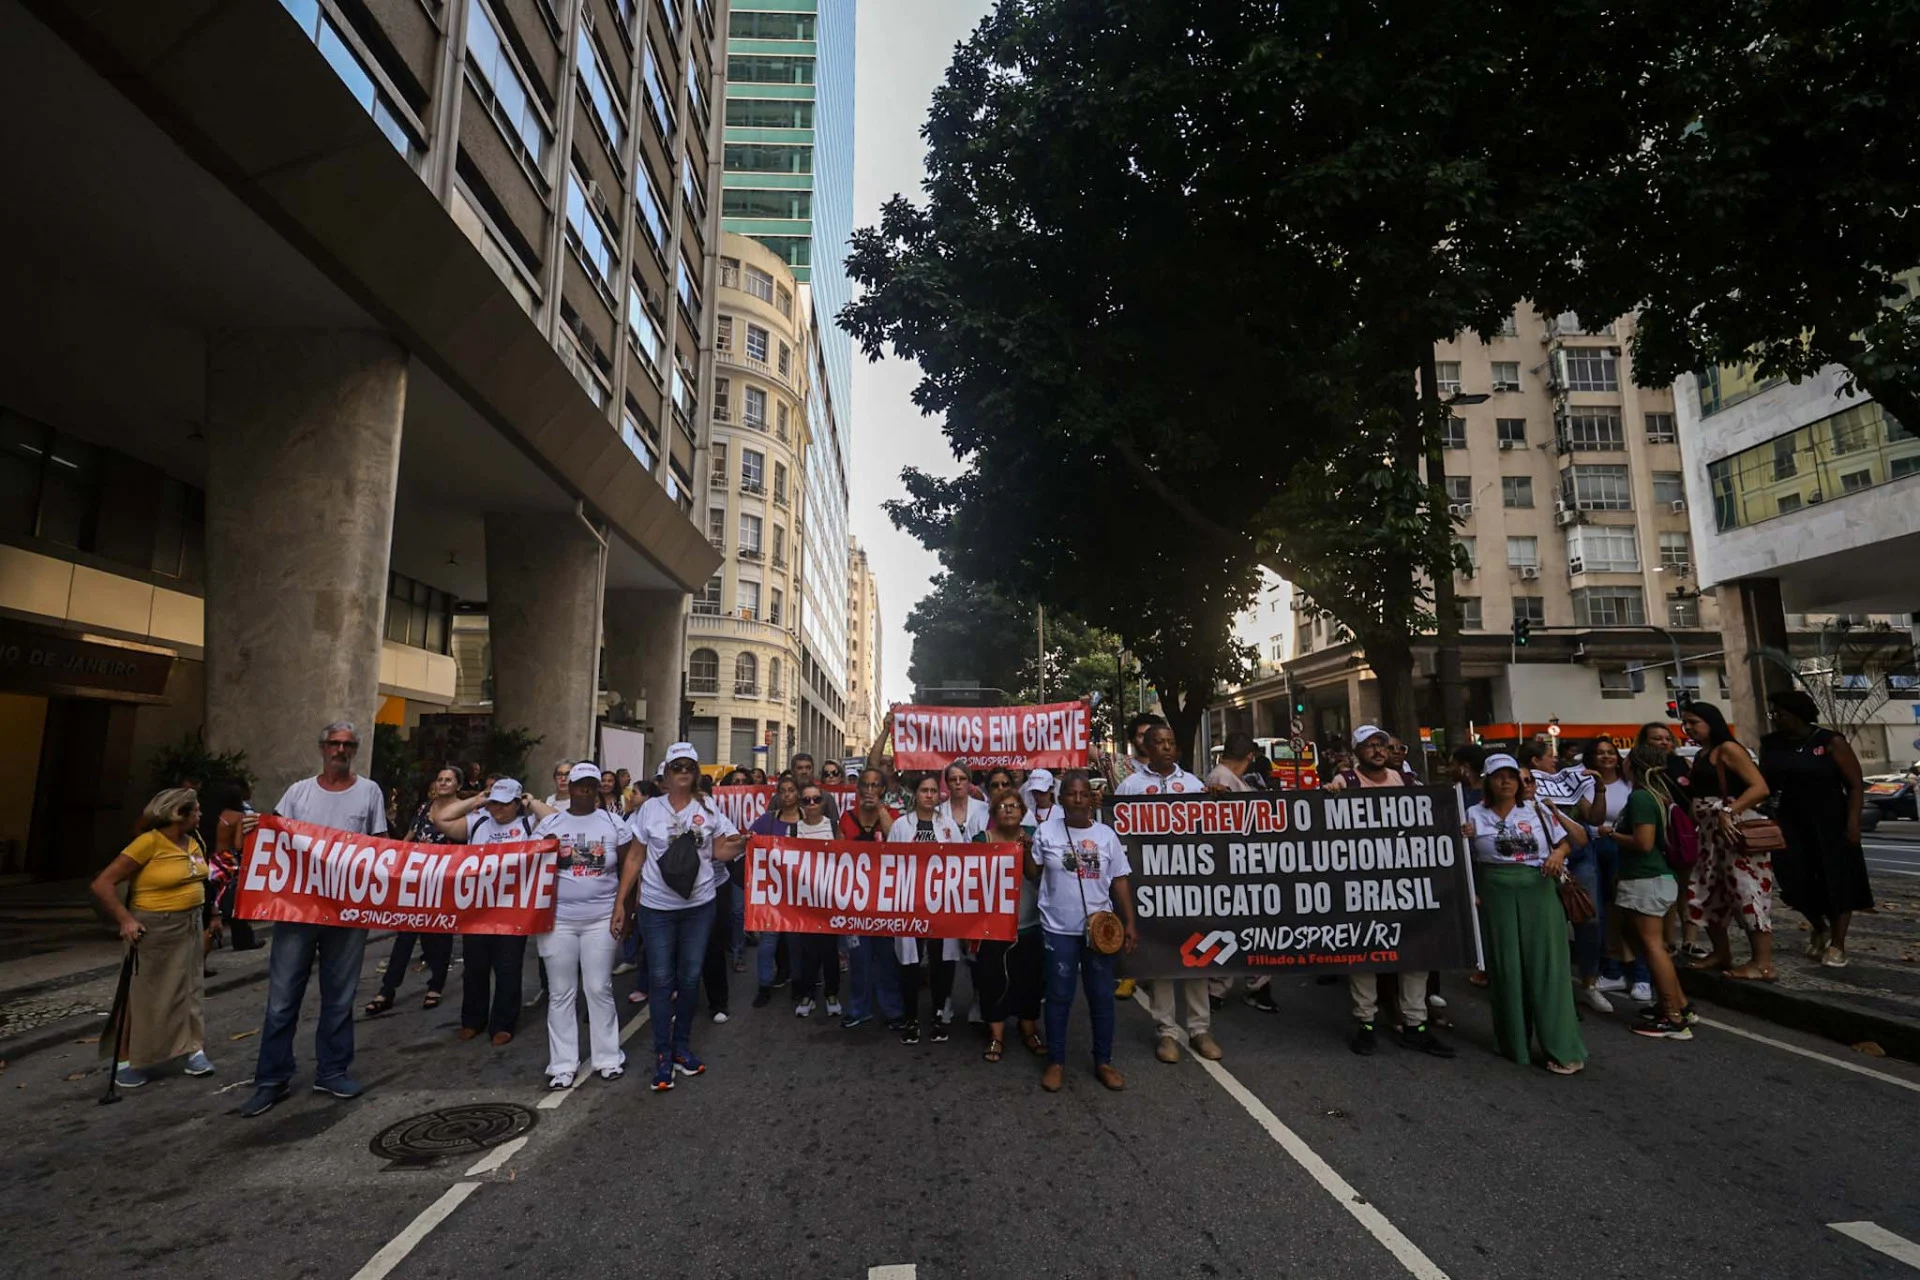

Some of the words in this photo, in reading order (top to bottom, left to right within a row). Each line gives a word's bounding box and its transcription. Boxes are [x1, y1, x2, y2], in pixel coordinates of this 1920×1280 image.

[28, 649, 57, 668] DE
[64, 656, 137, 676] JANEIRO
[893, 713, 983, 753] ESTAMOS
[989, 715, 1017, 752] EM
[1022, 709, 1087, 751] GREVE
[968, 756, 1027, 767] SINDSPREV/RJ
[1114, 799, 1288, 836] SINDSPREV/RJ
[1294, 800, 1311, 831] O
[1324, 795, 1434, 830] MELHOR
[244, 828, 397, 906] ESTAMOS
[397, 851, 451, 908] EM
[454, 852, 558, 910] GREVE
[1142, 843, 1215, 876] MAIS
[1228, 831, 1455, 875] REVOLUCIONÁRIO
[750, 848, 871, 911] ESTAMOS
[877, 854, 917, 912] EM
[924, 854, 1015, 914] GREVE
[1137, 883, 1281, 918] SINDICATO
[1295, 882, 1331, 914] DO
[1345, 877, 1440, 912] BRASIL
[360, 909, 456, 930] SINDSPREV/RJ
[847, 916, 929, 933] SINDSPREV/RJ
[1240, 920, 1401, 951] SINDSPREV/RJ
[1247, 954, 1295, 966] Filiado
[1370, 950, 1398, 962] CTB
